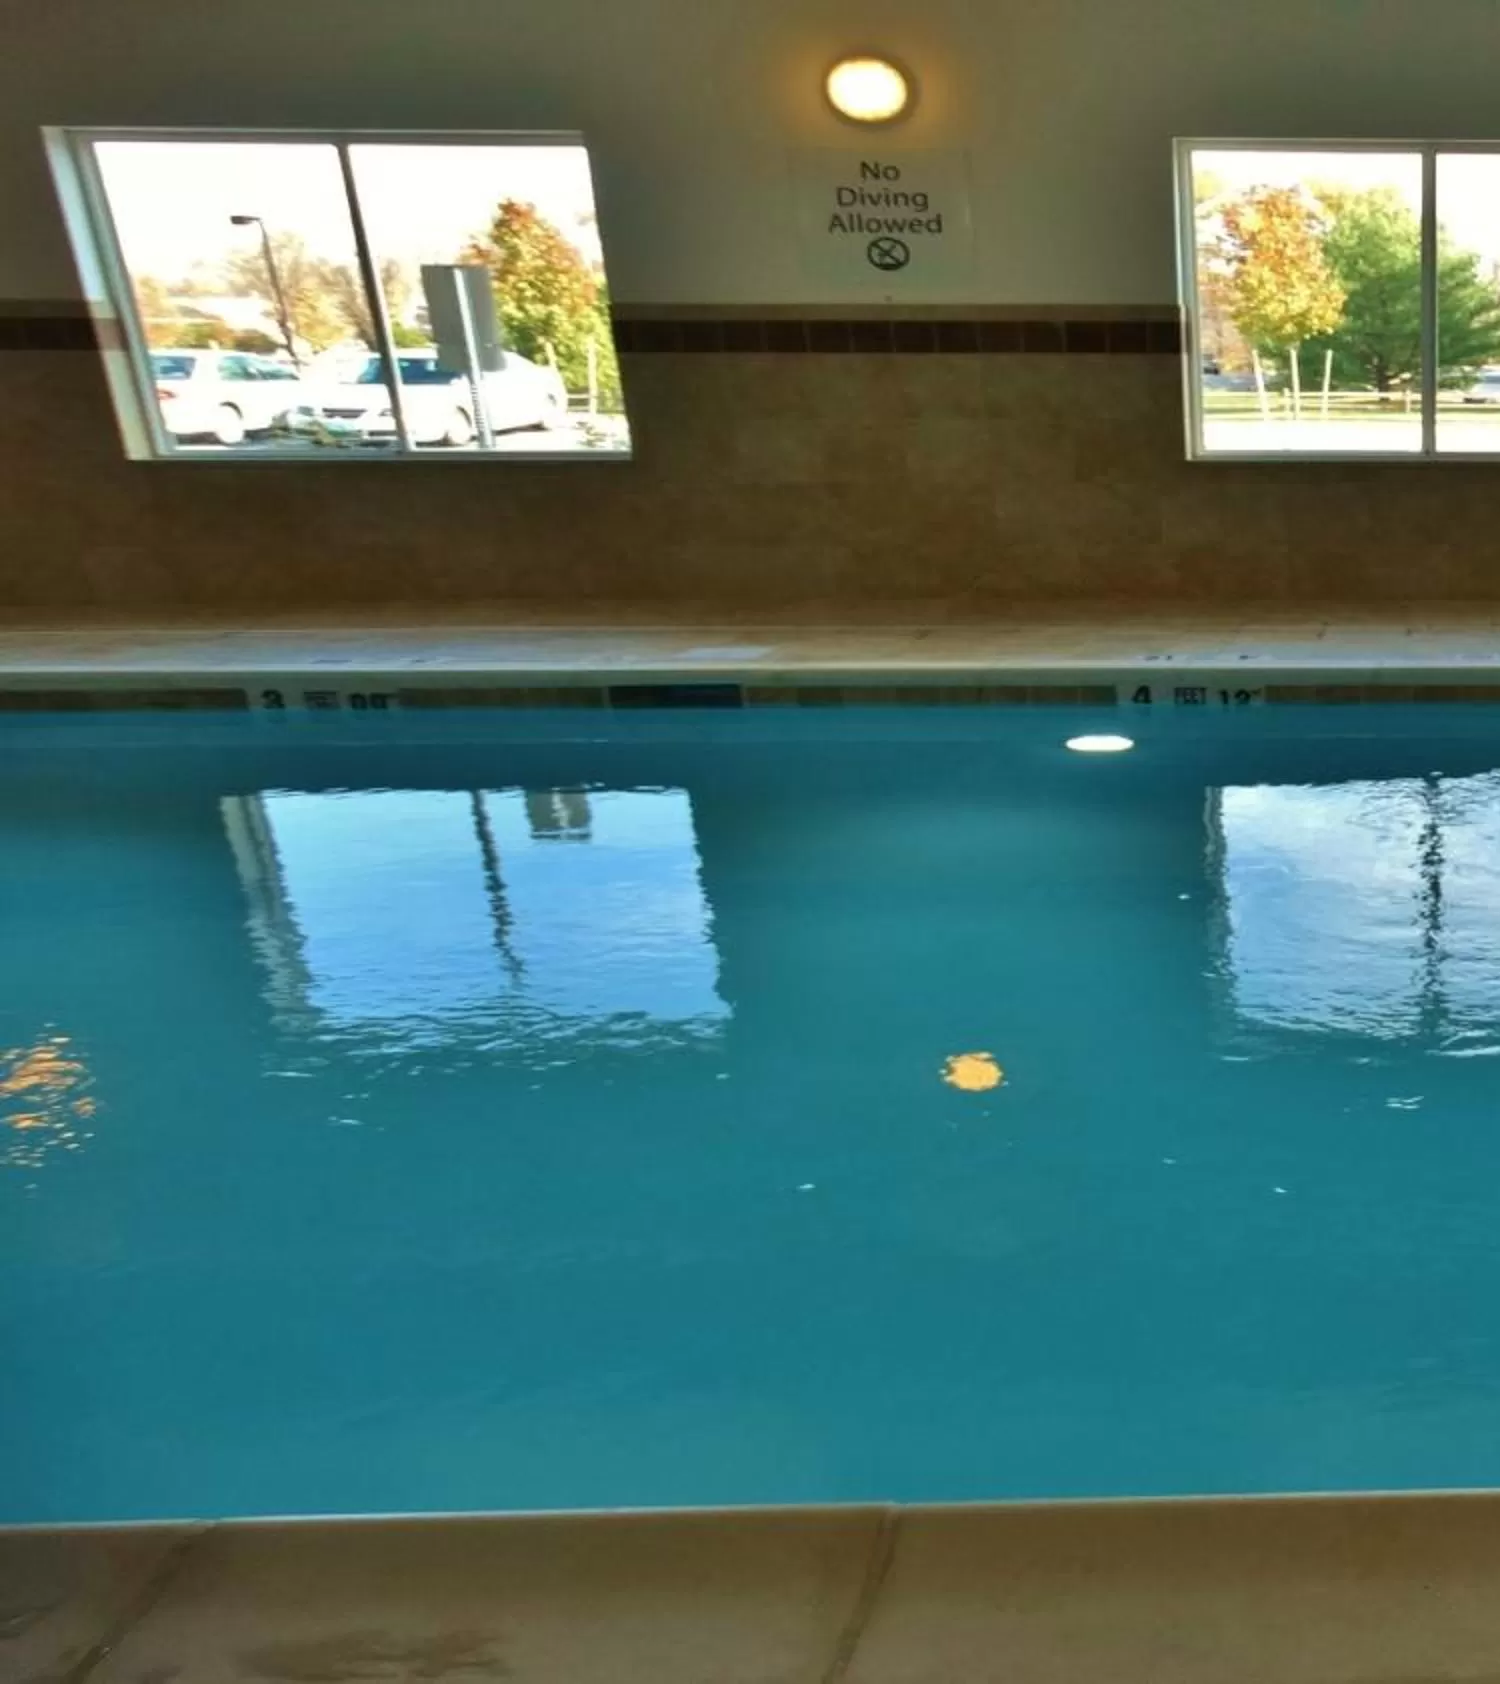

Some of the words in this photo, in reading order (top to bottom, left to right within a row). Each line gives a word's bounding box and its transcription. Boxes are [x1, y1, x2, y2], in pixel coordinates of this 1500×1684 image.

[859, 161, 901, 181] No
[836, 186, 929, 212] Diving
[828, 212, 943, 234] Allowed
[1131, 685, 1152, 704] 4
